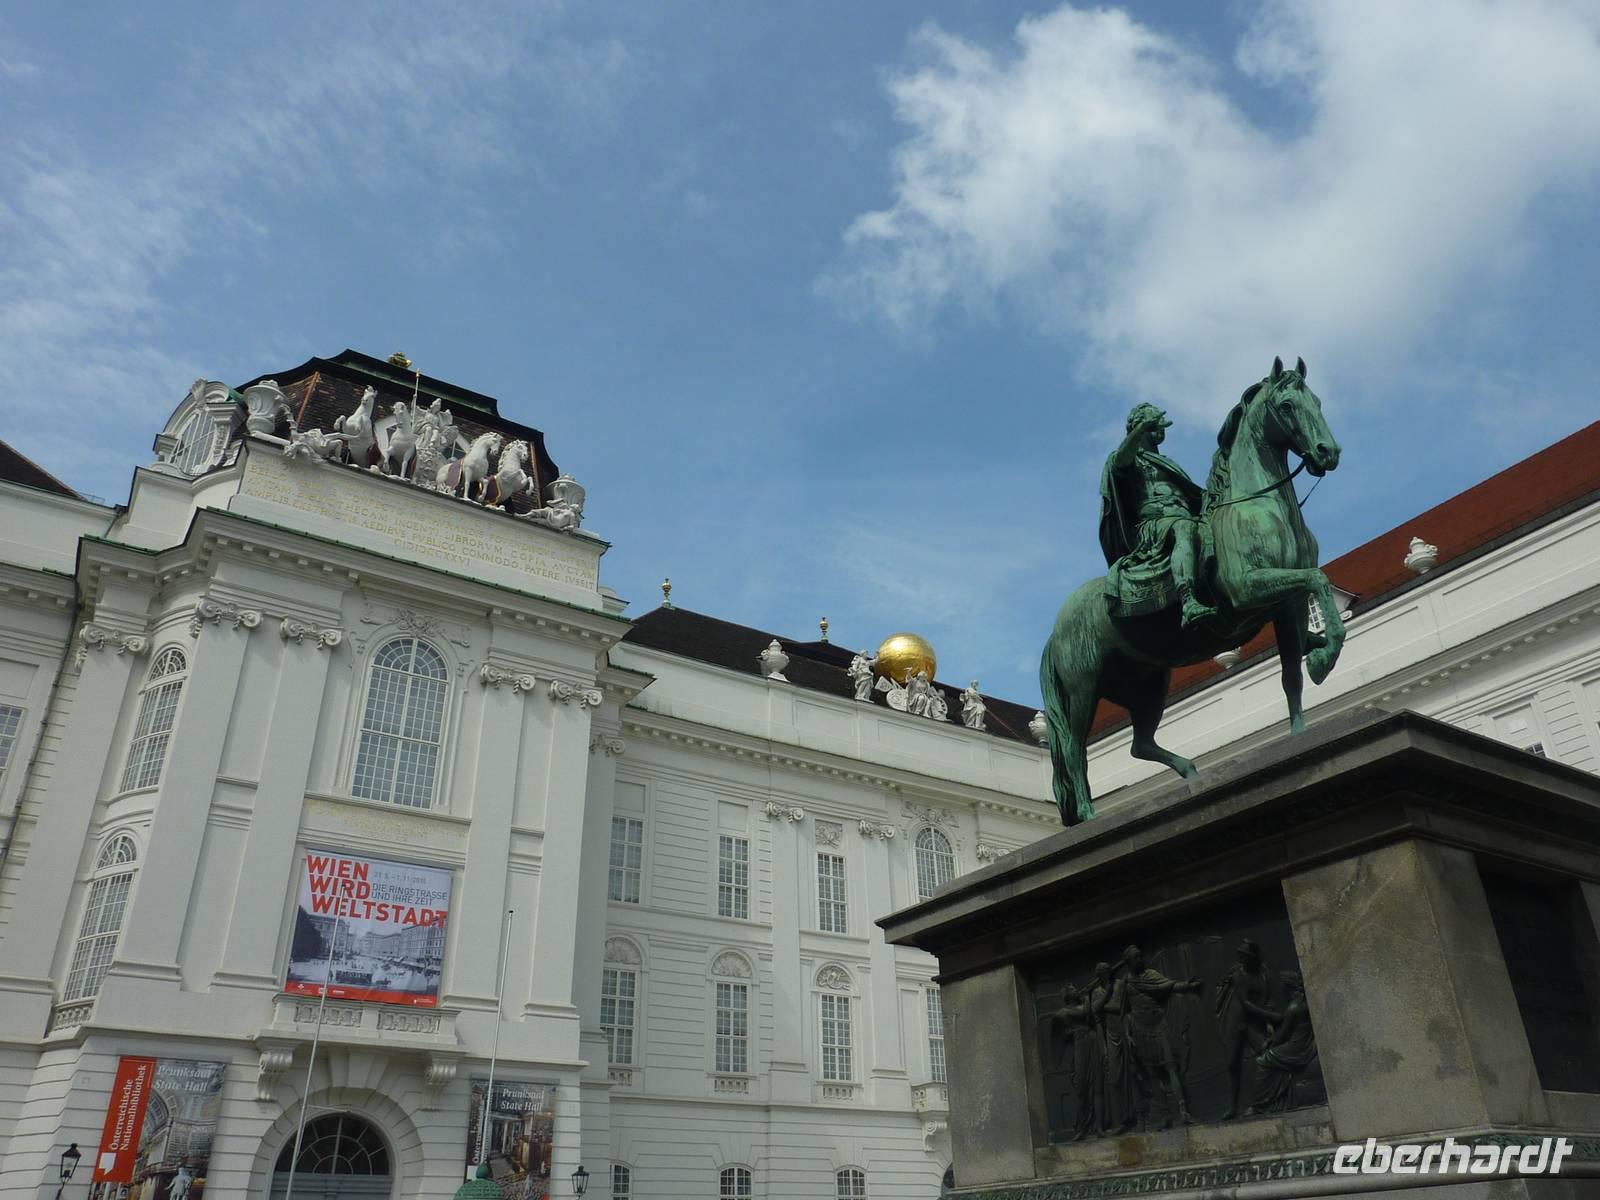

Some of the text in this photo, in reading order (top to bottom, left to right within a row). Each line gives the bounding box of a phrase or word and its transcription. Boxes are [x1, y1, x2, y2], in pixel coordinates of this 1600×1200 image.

[307, 855, 369, 881] WIEN
[309, 874, 371, 900] WIRD
[371, 891, 433, 907] UND IHRE ZEIT
[373, 882, 448, 900] DIE RINGSTRASSE
[311, 894, 449, 928] WELTSTADT
[155, 1080, 208, 1092] State Hall
[109, 1079, 134, 1151] Österreichische
[120, 1064, 147, 1152] Nationalbibliothek
[501, 1101, 542, 1112] State Hall
